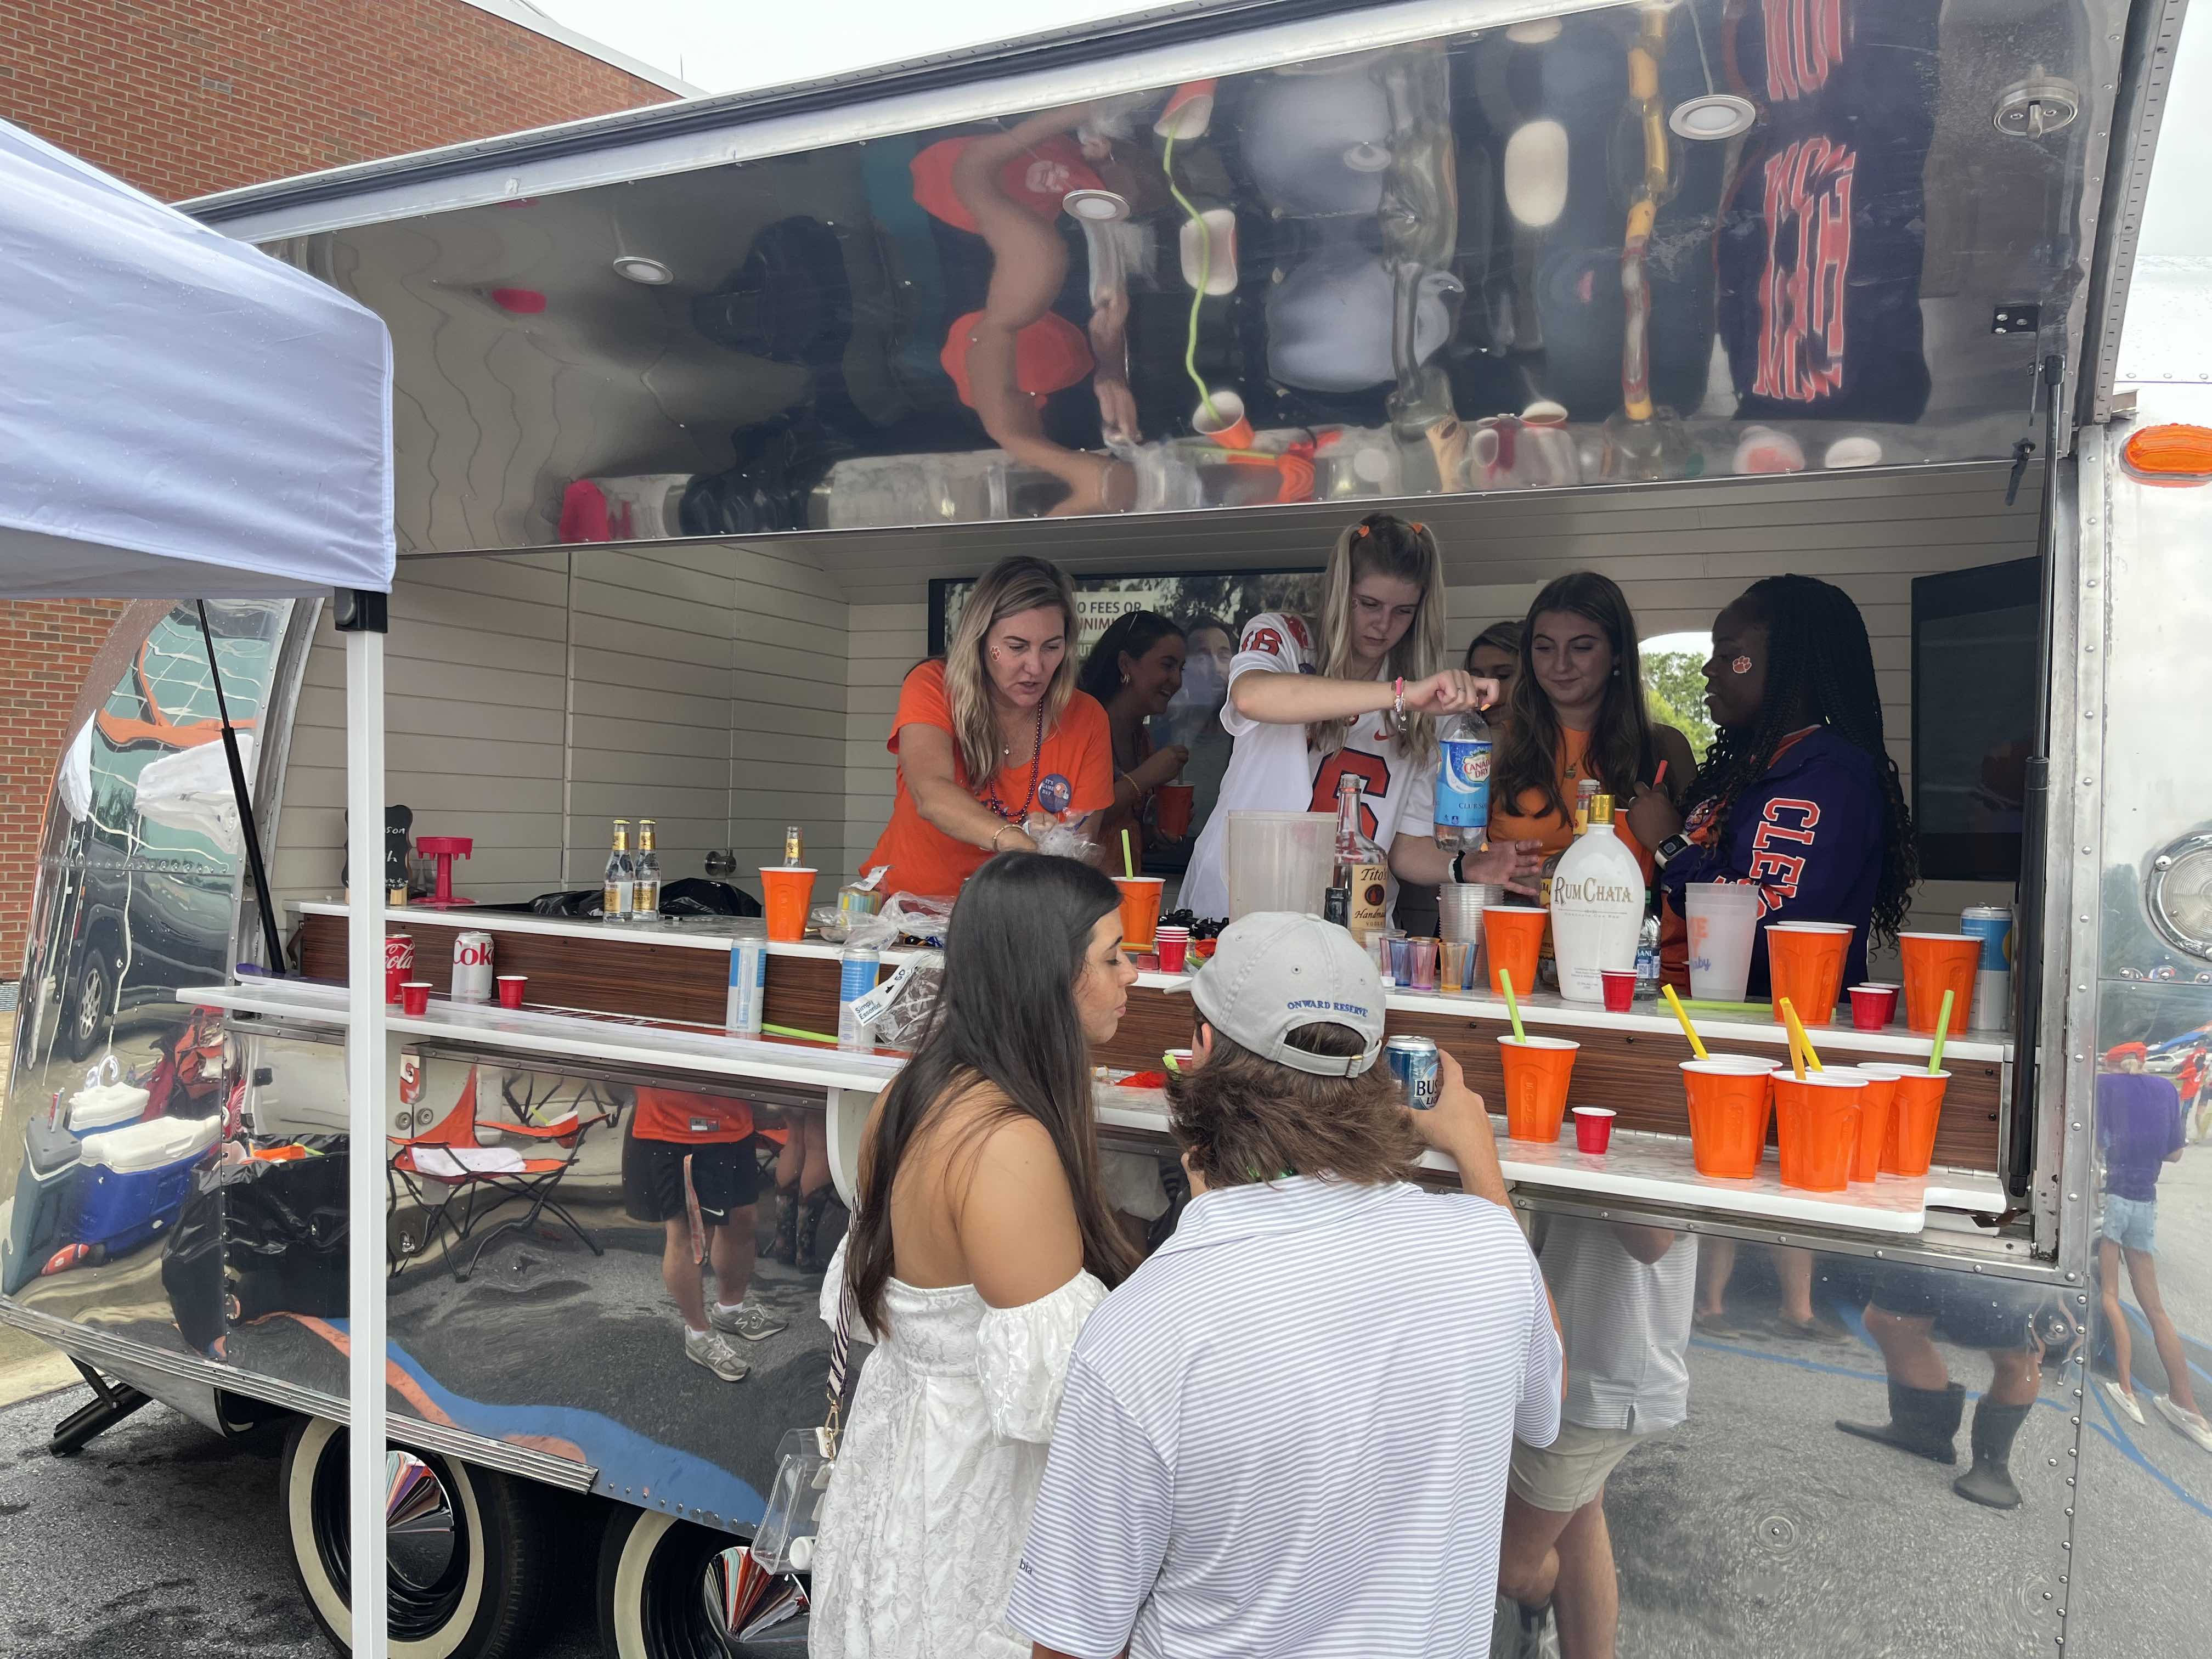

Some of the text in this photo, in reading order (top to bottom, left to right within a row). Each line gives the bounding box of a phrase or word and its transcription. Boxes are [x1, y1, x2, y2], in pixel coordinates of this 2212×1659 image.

[1090, 601, 1120, 614] FEES
[1124, 601, 1142, 613] OR
[1464, 759, 1491, 773] CANAD
[1475, 769, 1488, 778] DRY
[386, 826, 405, 834] son
[453, 940, 494, 966] Cok
[1286, 1000, 1369, 1018] ONWARD RESERVE
[1415, 1079, 1438, 1096] BUS
